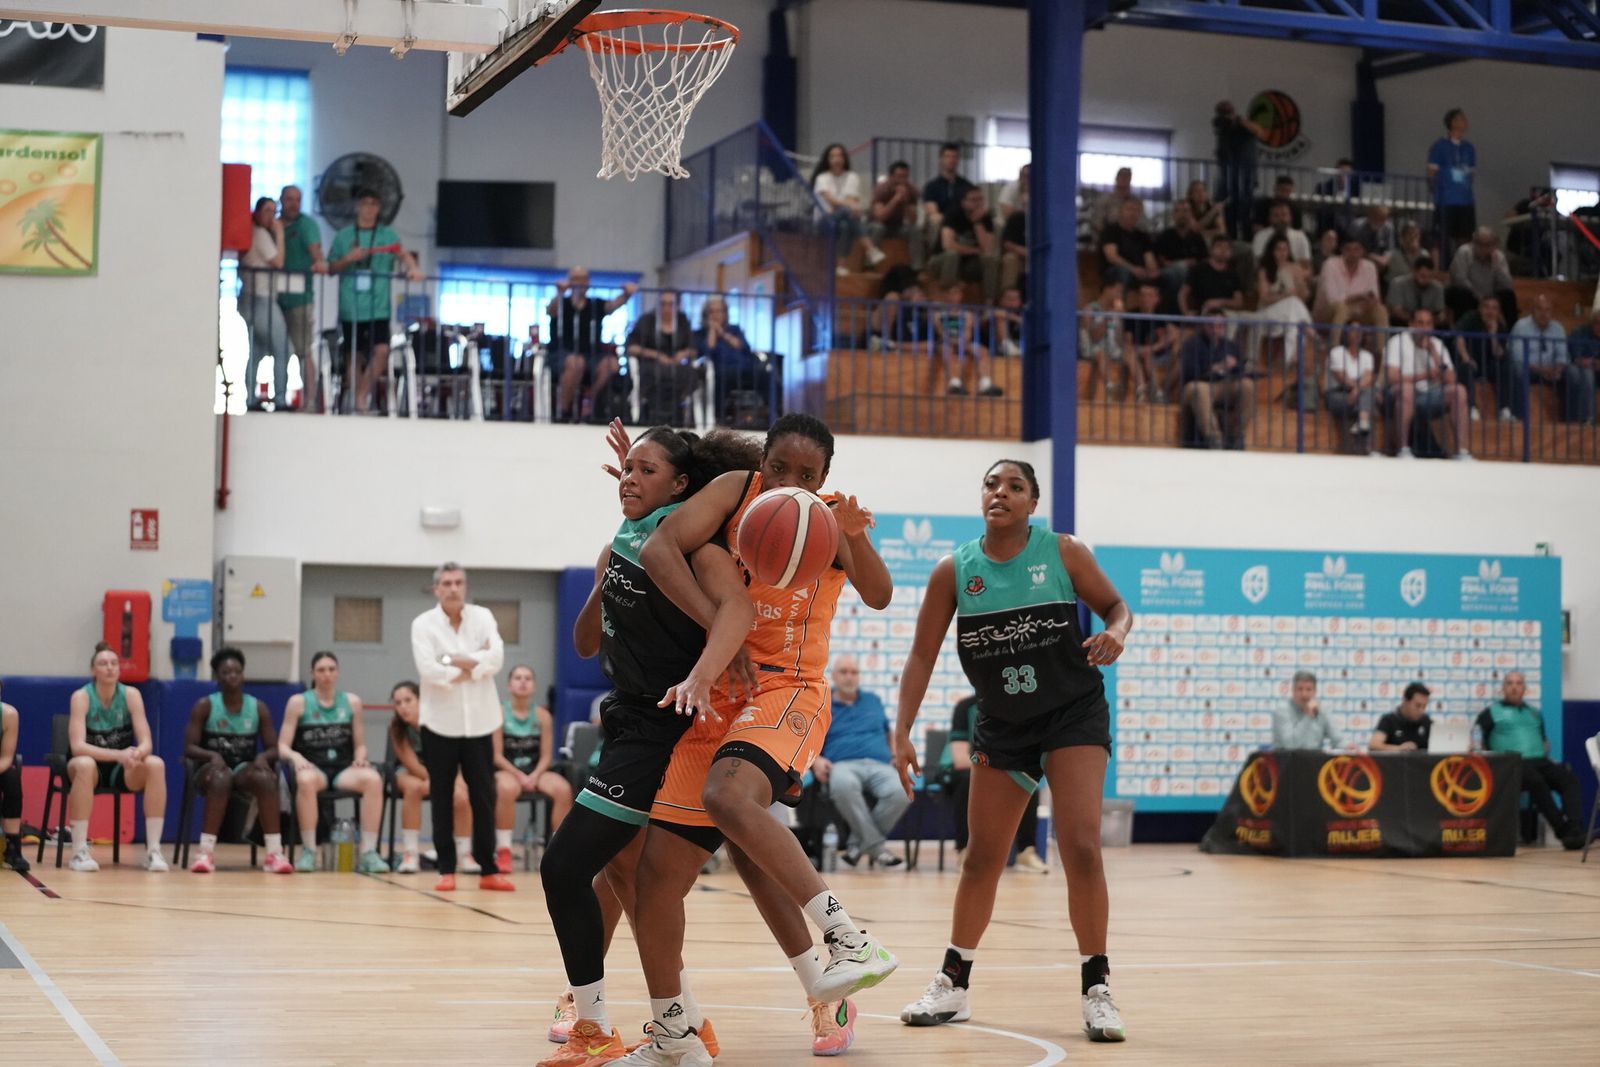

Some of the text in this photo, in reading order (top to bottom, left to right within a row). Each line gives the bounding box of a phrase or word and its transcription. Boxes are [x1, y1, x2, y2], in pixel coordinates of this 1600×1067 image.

[753, 600, 783, 620] tas
[1002, 665, 1038, 695] 33
[1328, 829, 1381, 845] MUJER
